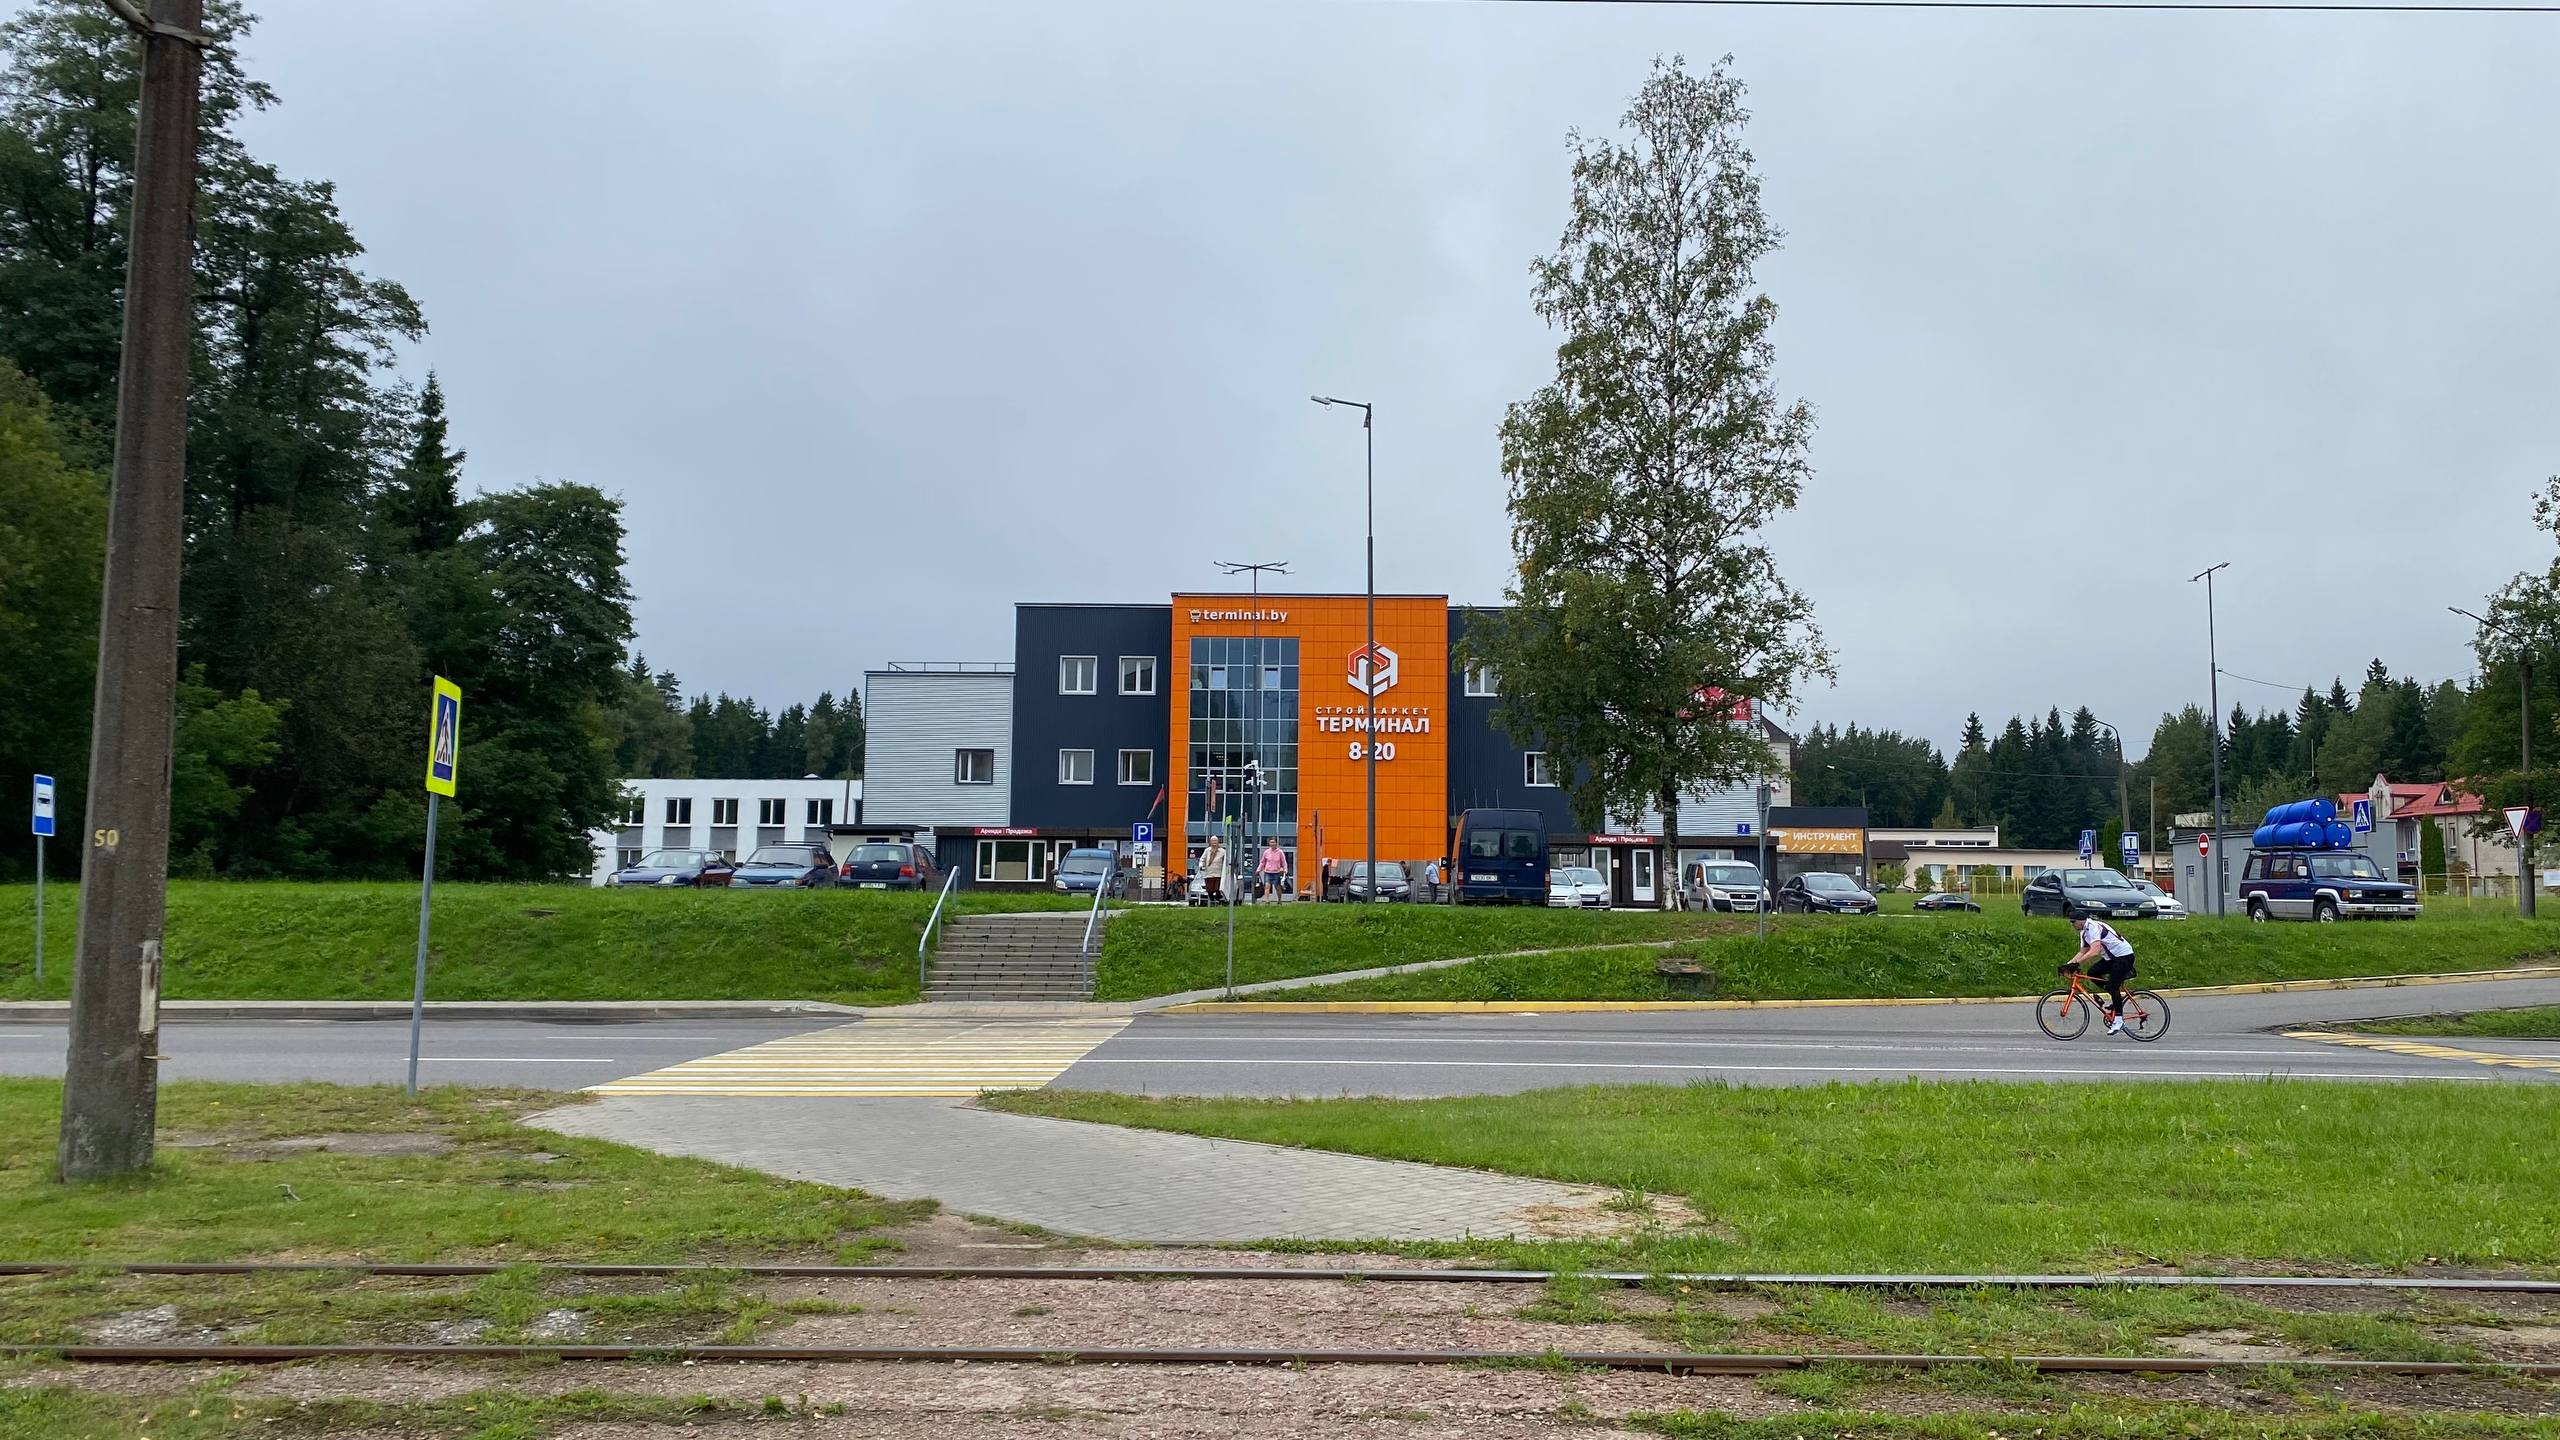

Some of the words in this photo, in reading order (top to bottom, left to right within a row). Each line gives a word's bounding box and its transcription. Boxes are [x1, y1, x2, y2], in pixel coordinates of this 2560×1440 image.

[1203, 609, 1287, 622] terminal.by
[1315, 706, 1429, 715] СТРОЙАРКЕТ
[1316, 716, 1430, 733] ТЕРМИНАЛ
[1348, 742, 1395, 760] 8-20
[1137, 825, 1149, 840] P
[1594, 835, 1617, 843] Аренда
[1792, 832, 1857, 841] ИНСТРУМЕНТ
